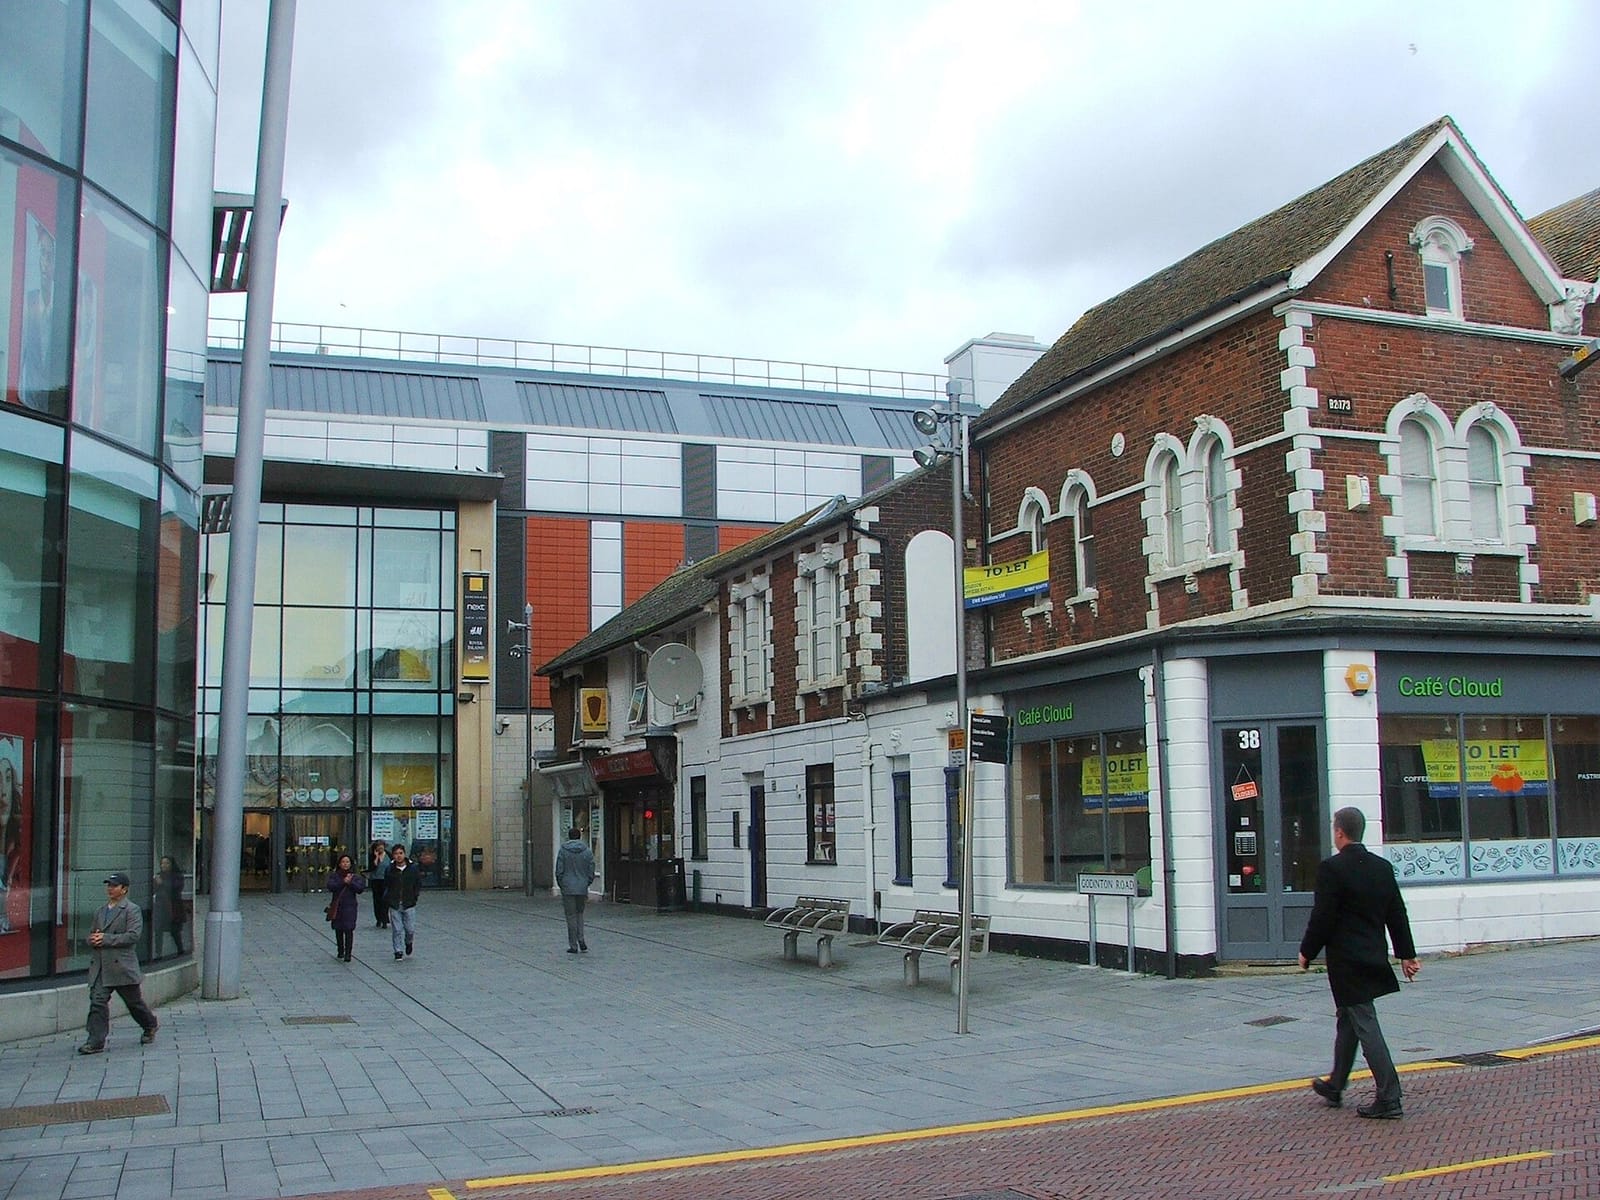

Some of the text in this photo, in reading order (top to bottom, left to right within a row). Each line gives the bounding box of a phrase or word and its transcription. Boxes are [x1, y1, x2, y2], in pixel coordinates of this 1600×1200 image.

[984, 560, 1029, 577] TO LET
[1399, 676, 1503, 697] Café Cloud
[1018, 702, 1073, 726] Café Cloud
[1238, 729, 1260, 749] 38
[1489, 745, 1521, 759] LET
[1120, 758, 1142, 771] LET
[1115, 879, 1135, 890] ROAD
